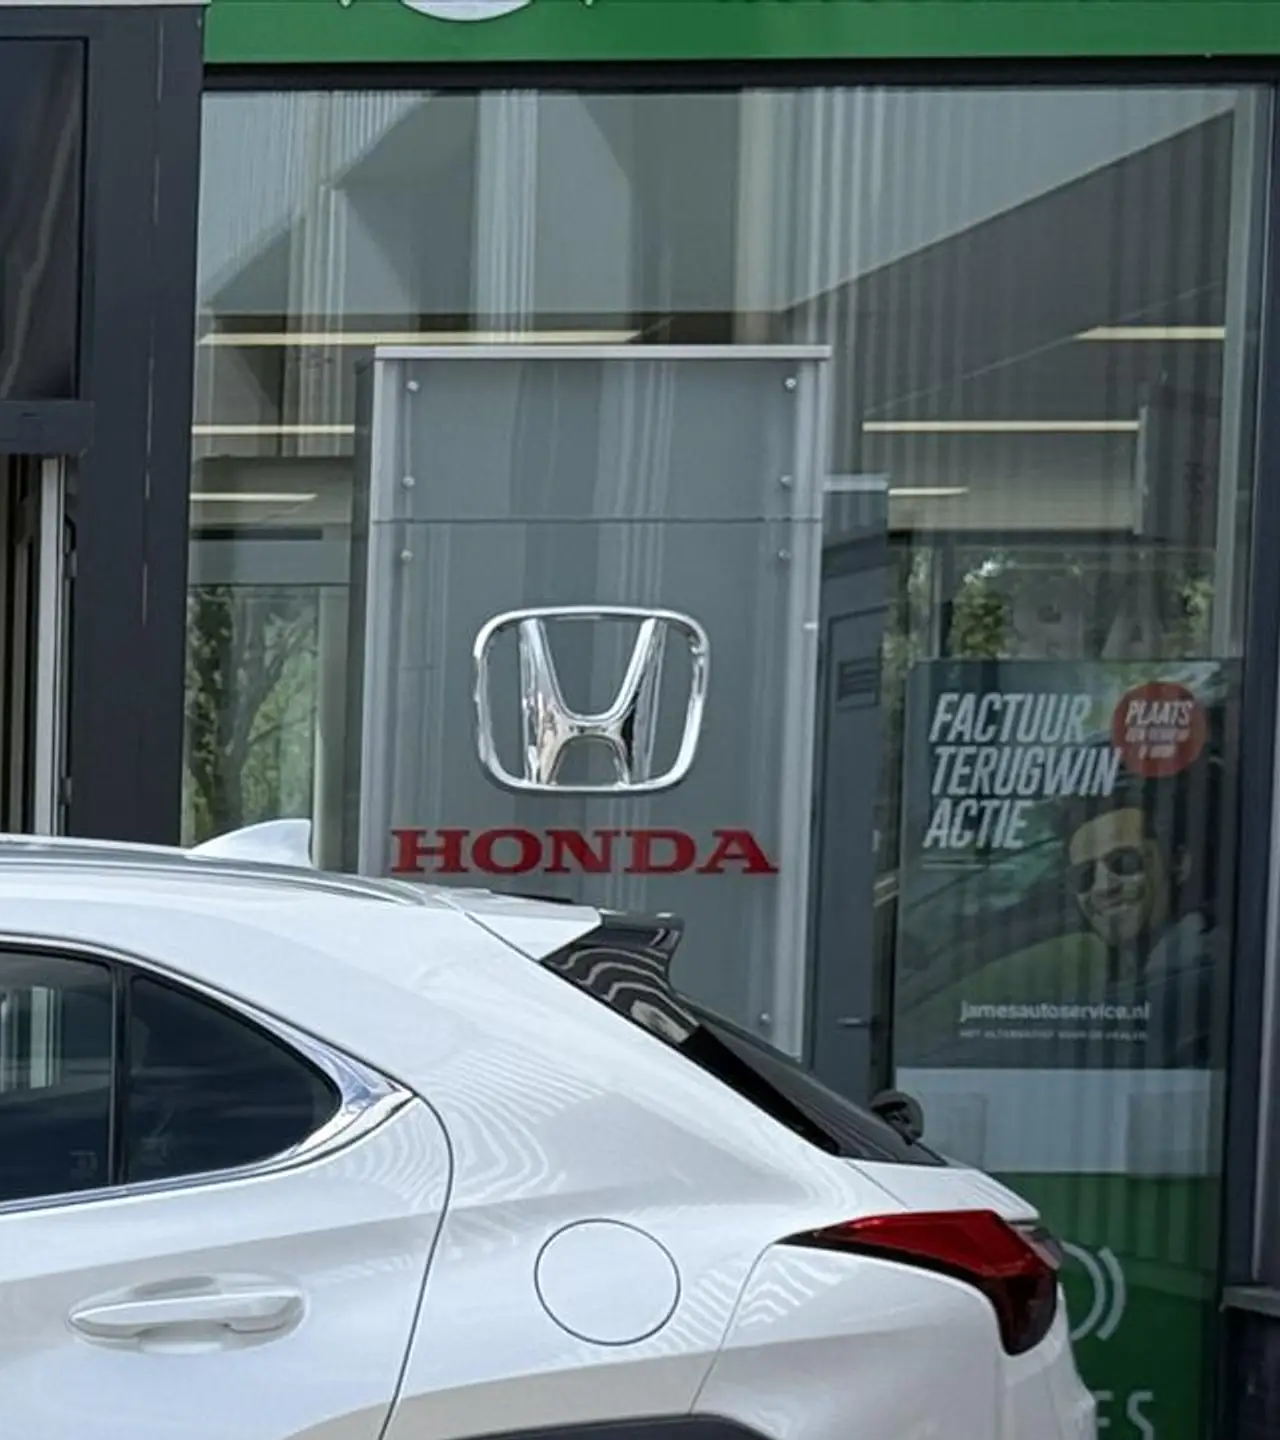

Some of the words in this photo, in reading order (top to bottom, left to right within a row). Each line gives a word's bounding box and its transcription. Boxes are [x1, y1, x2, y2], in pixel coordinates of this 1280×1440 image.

[928, 691, 1093, 744] FACTUUR
[1124, 700, 1195, 727] PLAATS
[931, 745, 1122, 797] TERUGWIN
[921, 797, 1034, 849] ACTIE
[390, 828, 780, 875] HONDA
[959, 999, 1150, 1024] jamesautoservice.nl
